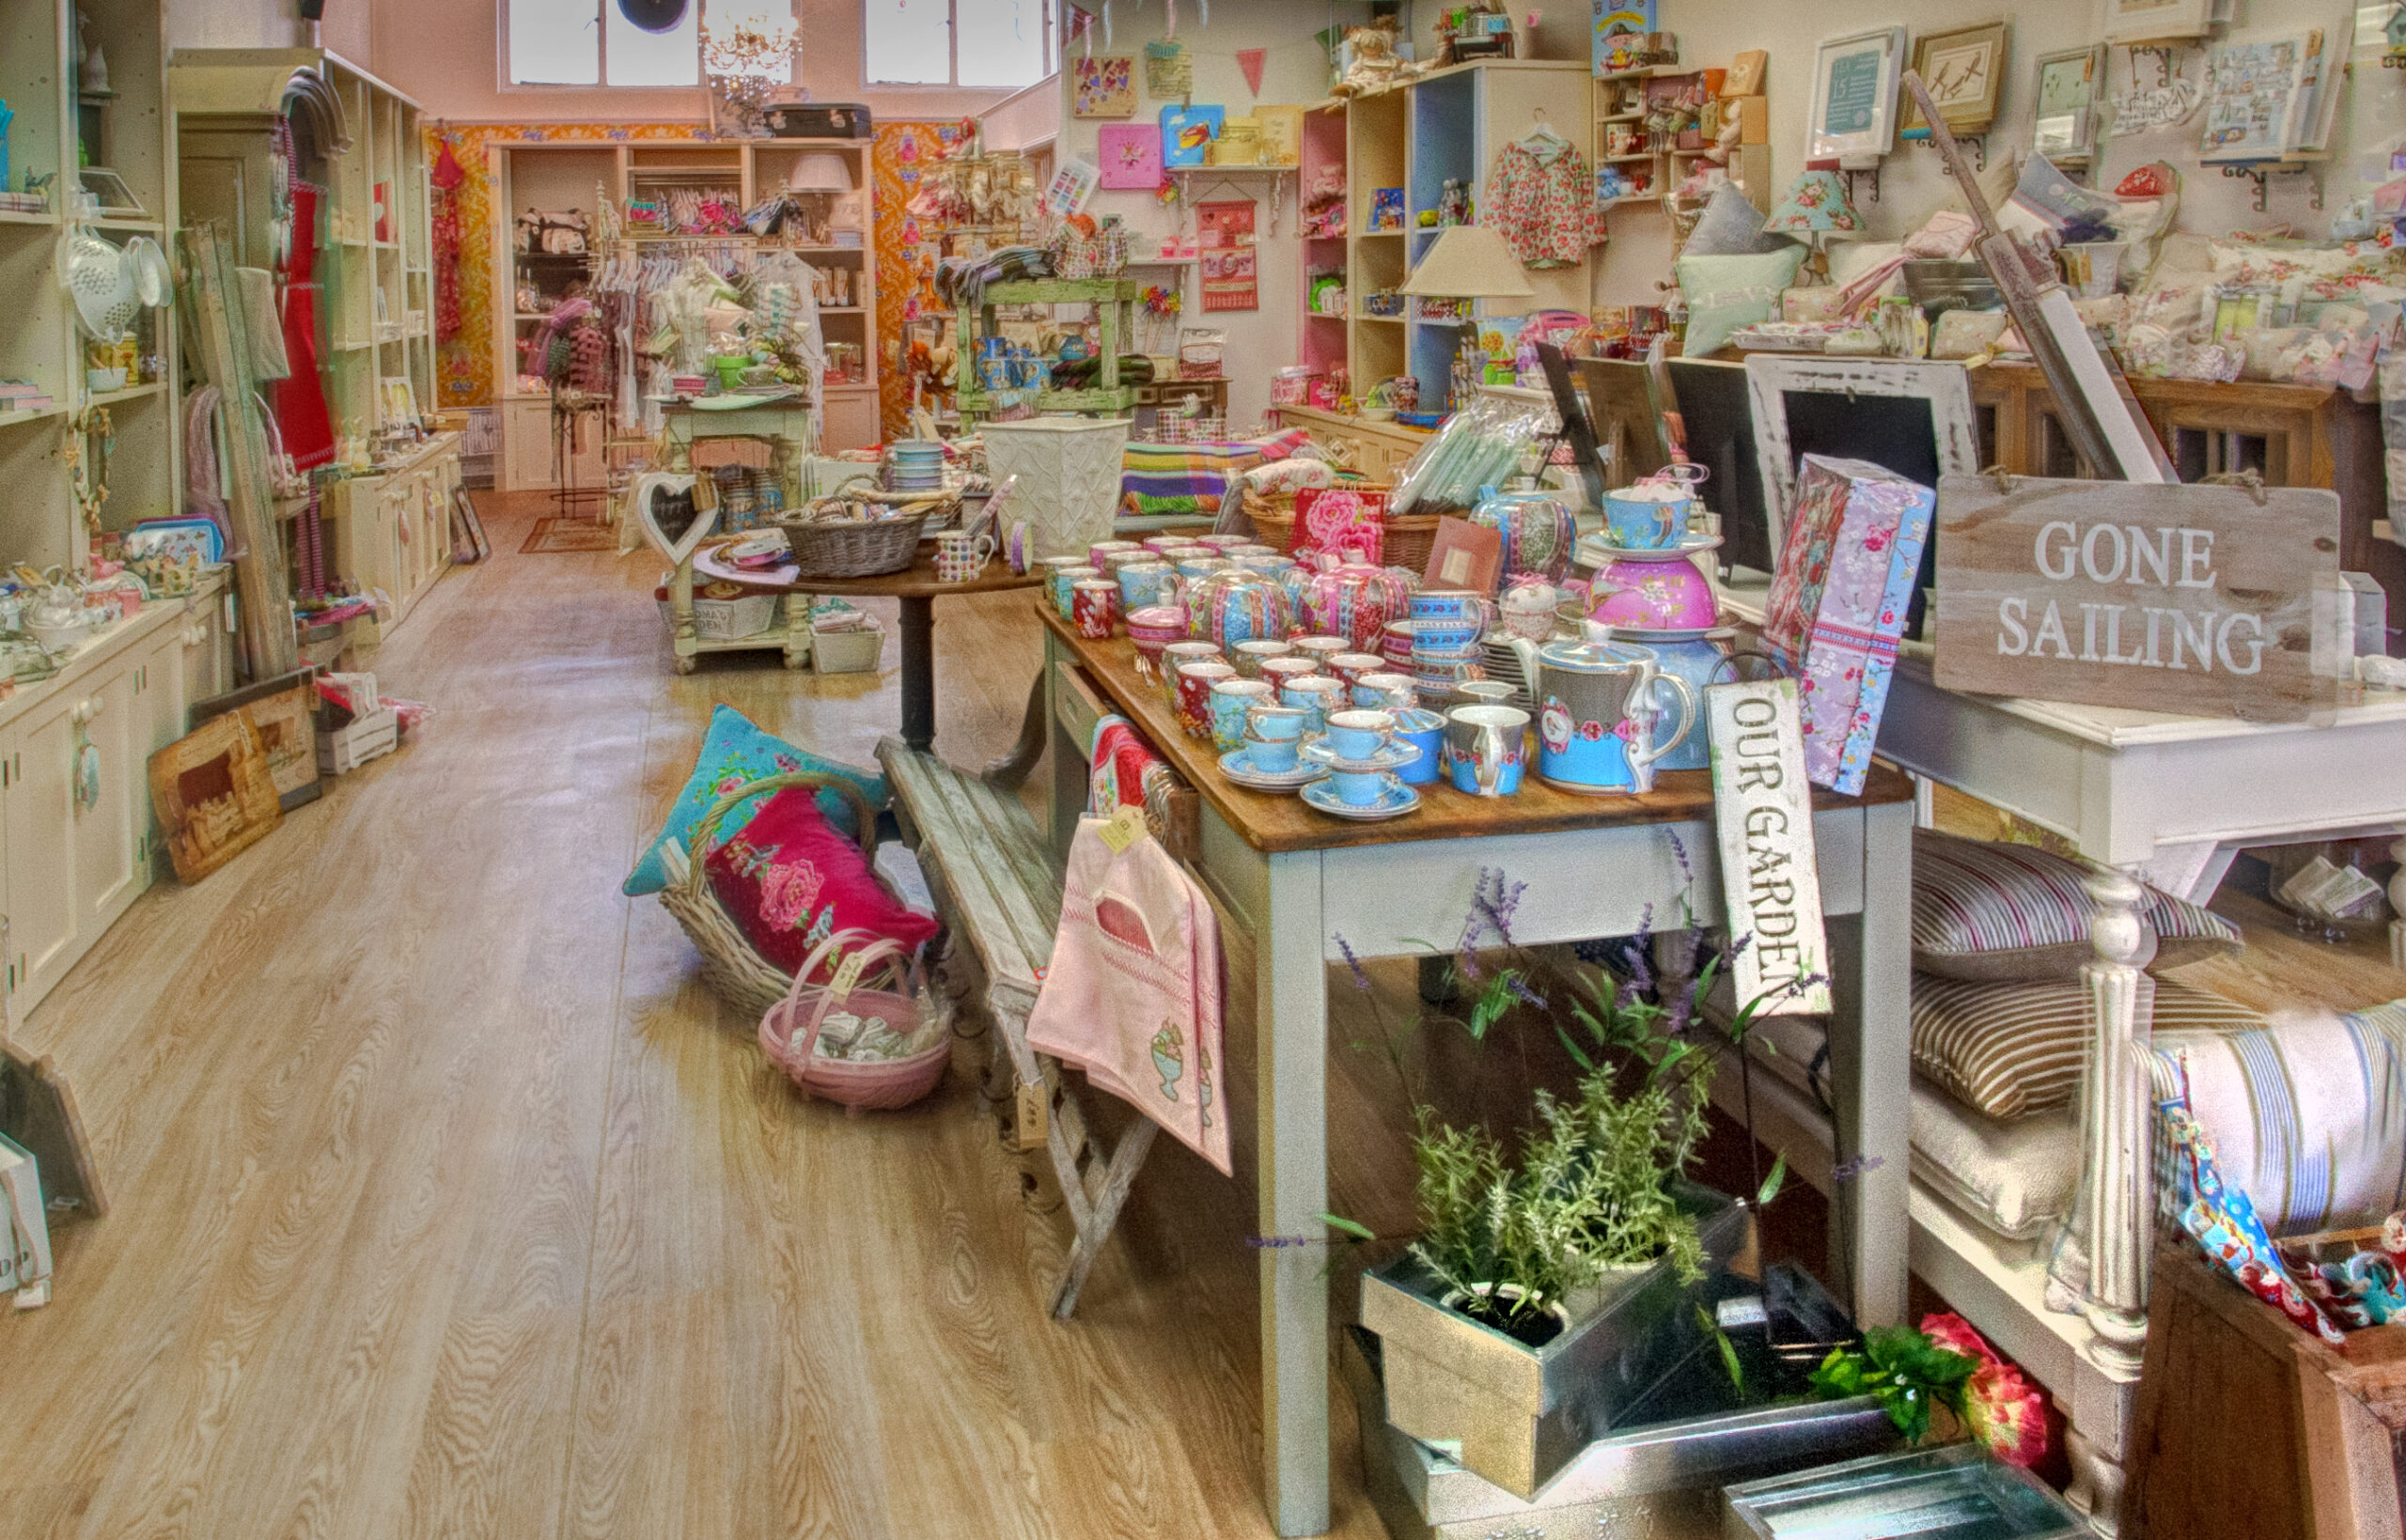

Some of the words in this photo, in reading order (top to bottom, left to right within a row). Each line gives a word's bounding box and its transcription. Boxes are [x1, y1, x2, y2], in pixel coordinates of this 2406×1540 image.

[2034, 520, 2219, 589] GONE
[1997, 598, 2267, 675] SAILING
[1732, 697, 1784, 793] OUR
[1744, 806, 1805, 1000] GARDEN
